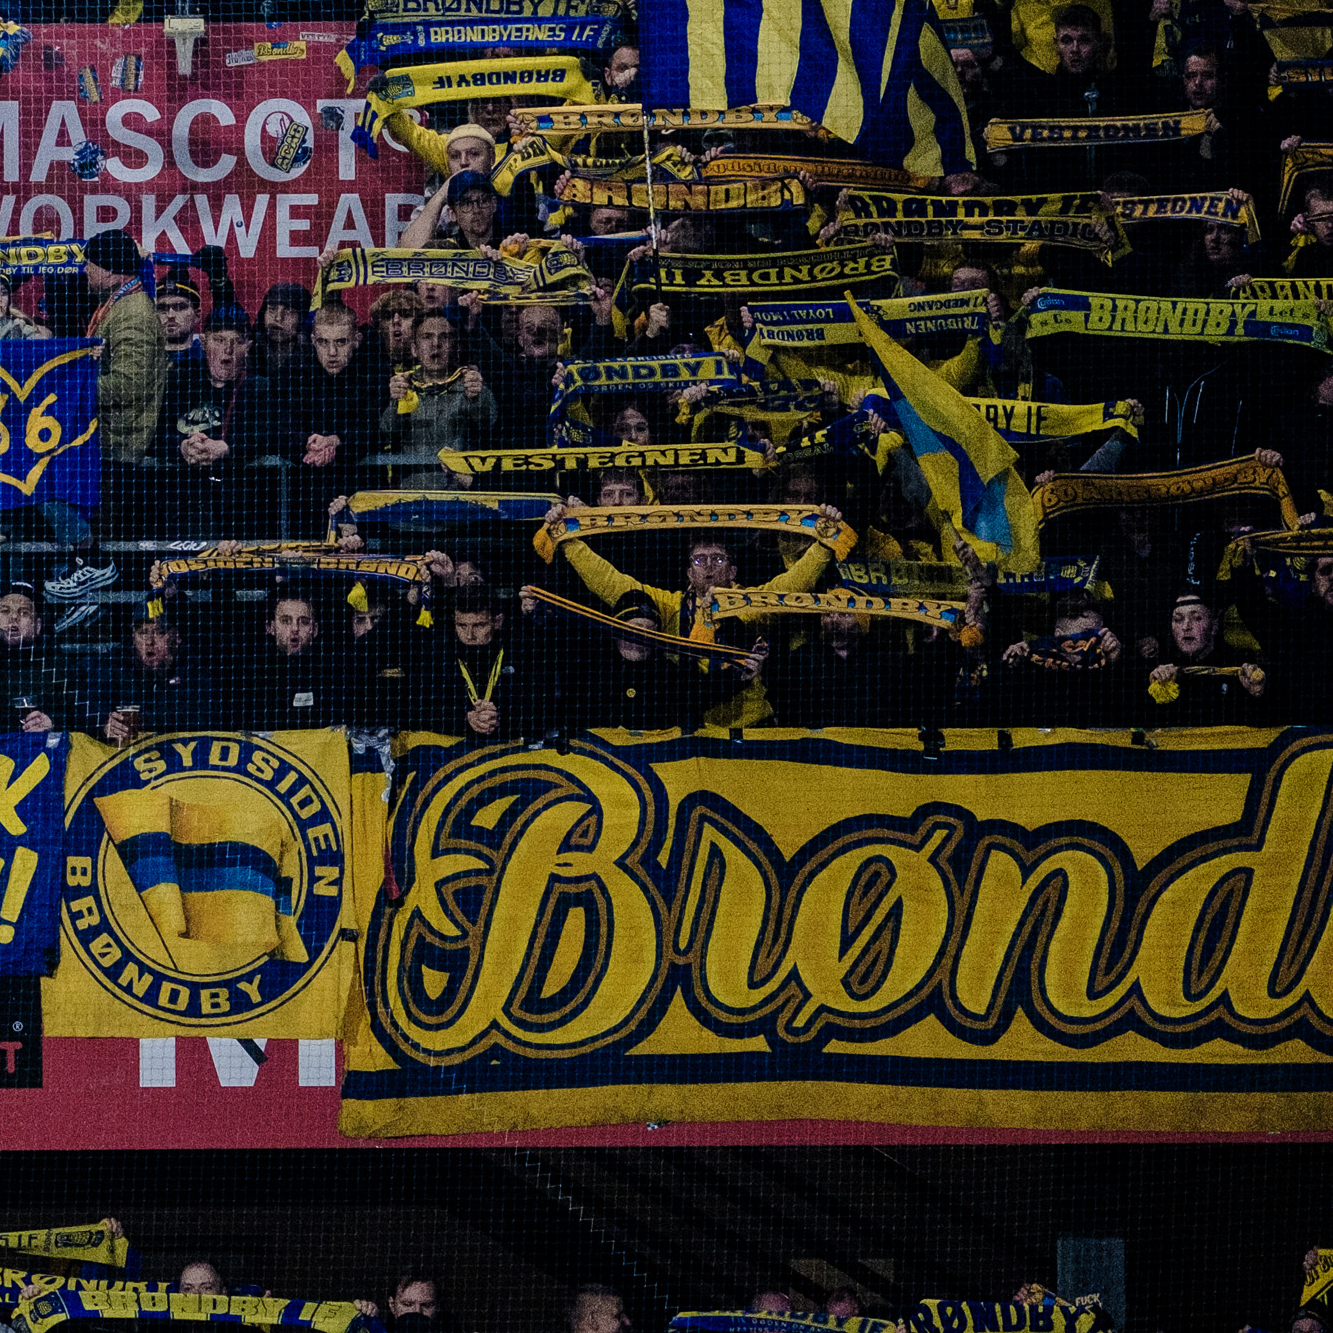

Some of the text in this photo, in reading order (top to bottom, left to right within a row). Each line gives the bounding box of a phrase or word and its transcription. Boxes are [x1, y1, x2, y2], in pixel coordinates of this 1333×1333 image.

[429, 22, 567, 43] BRØNDBYERNES
[484, 67, 567, 87] BRØNDBY
[1116, 195, 1241, 221] STEGNEN
[1084, 296, 1257, 338] BRØNDBY
[468, 447, 739, 472] VESTEGNEN
[132, 738, 342, 897] SYDSIDEN
[65, 854, 266, 1017] BRØNDBY
